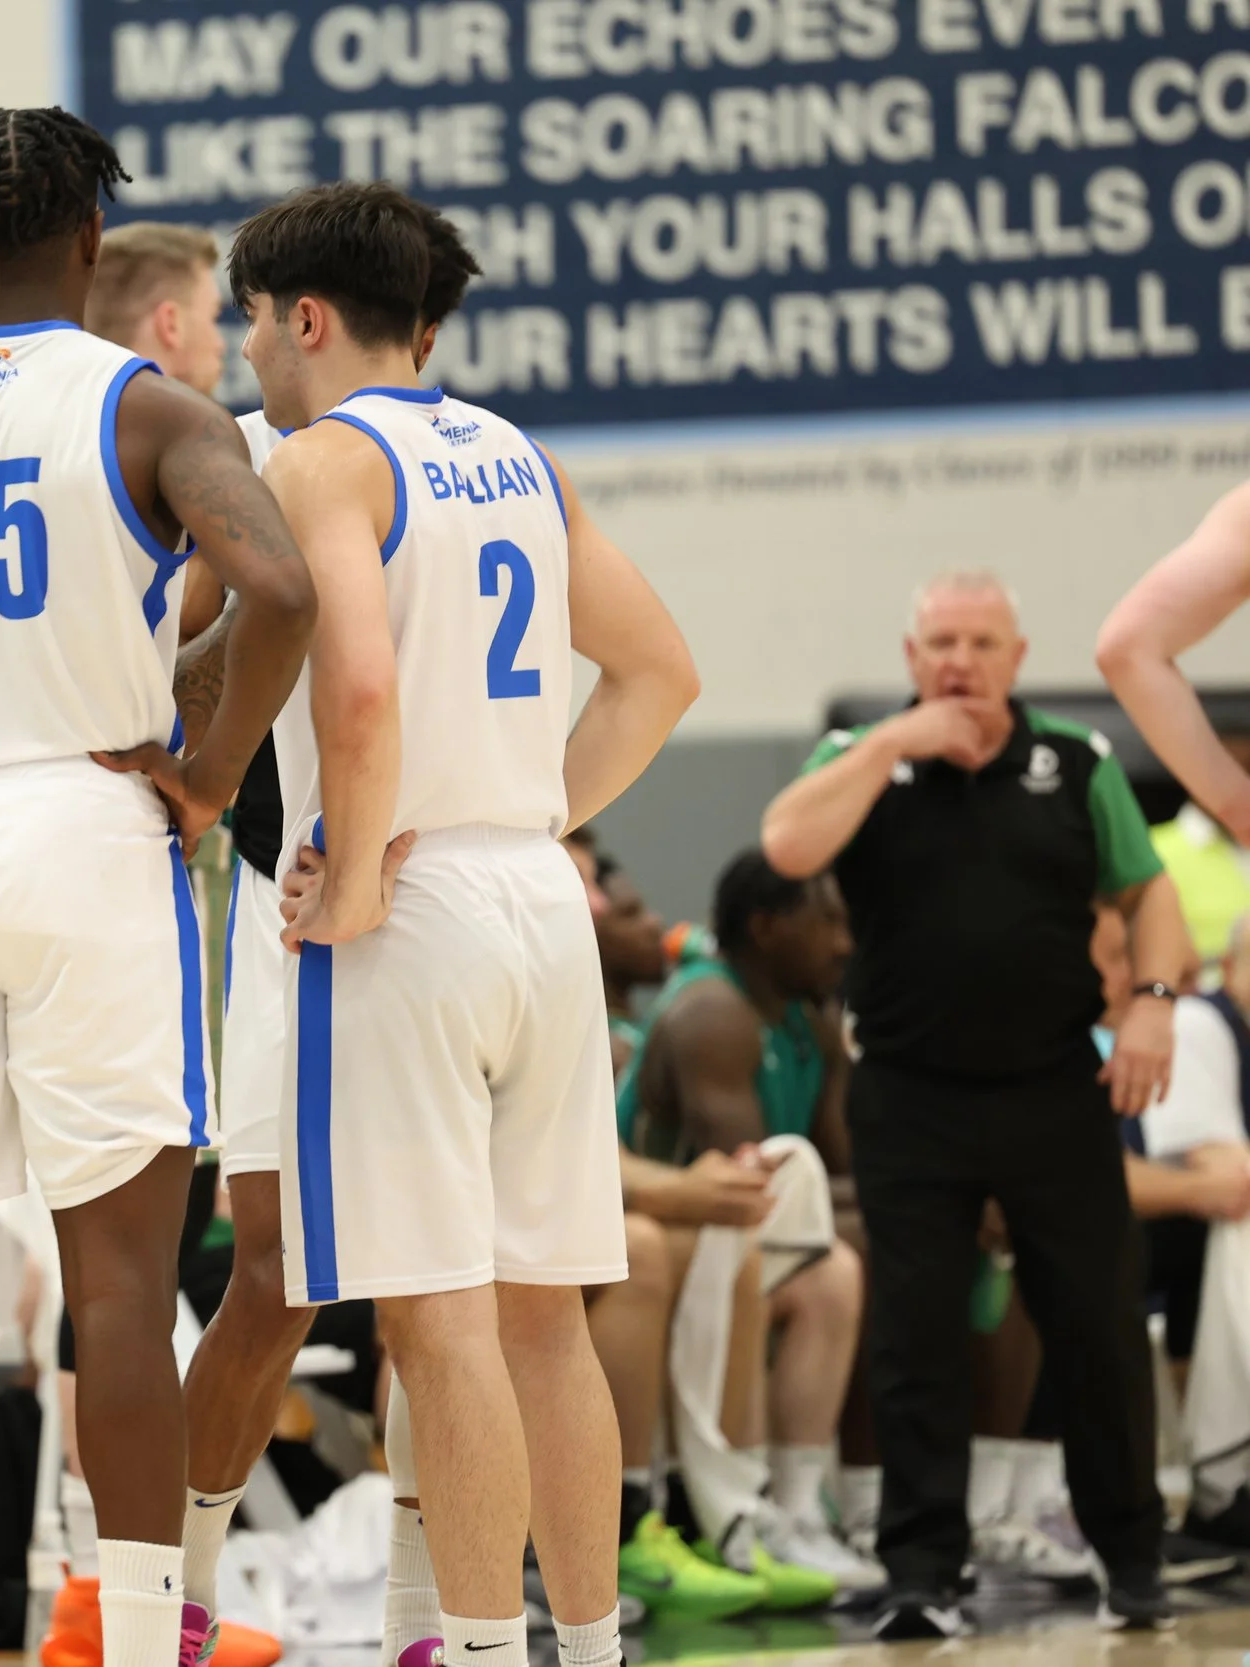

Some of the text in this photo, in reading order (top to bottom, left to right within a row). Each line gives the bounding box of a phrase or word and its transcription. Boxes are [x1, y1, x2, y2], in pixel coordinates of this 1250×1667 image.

[112, 10, 297, 101] MAY
[311, 2, 508, 92] OUR
[527, 0, 899, 79] ECHOES
[112, 113, 314, 206] LIKE
[323, 103, 508, 190] THE
[520, 76, 934, 184] SOARING
[570, 188, 829, 283] YOUR
[848, 166, 1152, 269] HALLS
[1171, 160, 1250, 248] O
[586, 284, 953, 386] HEARTS
[970, 271, 1199, 365] WILL
[421, 456, 542, 504] BALIAN
[437, 421, 482, 440] MENIA
[478, 539, 542, 700] 2
